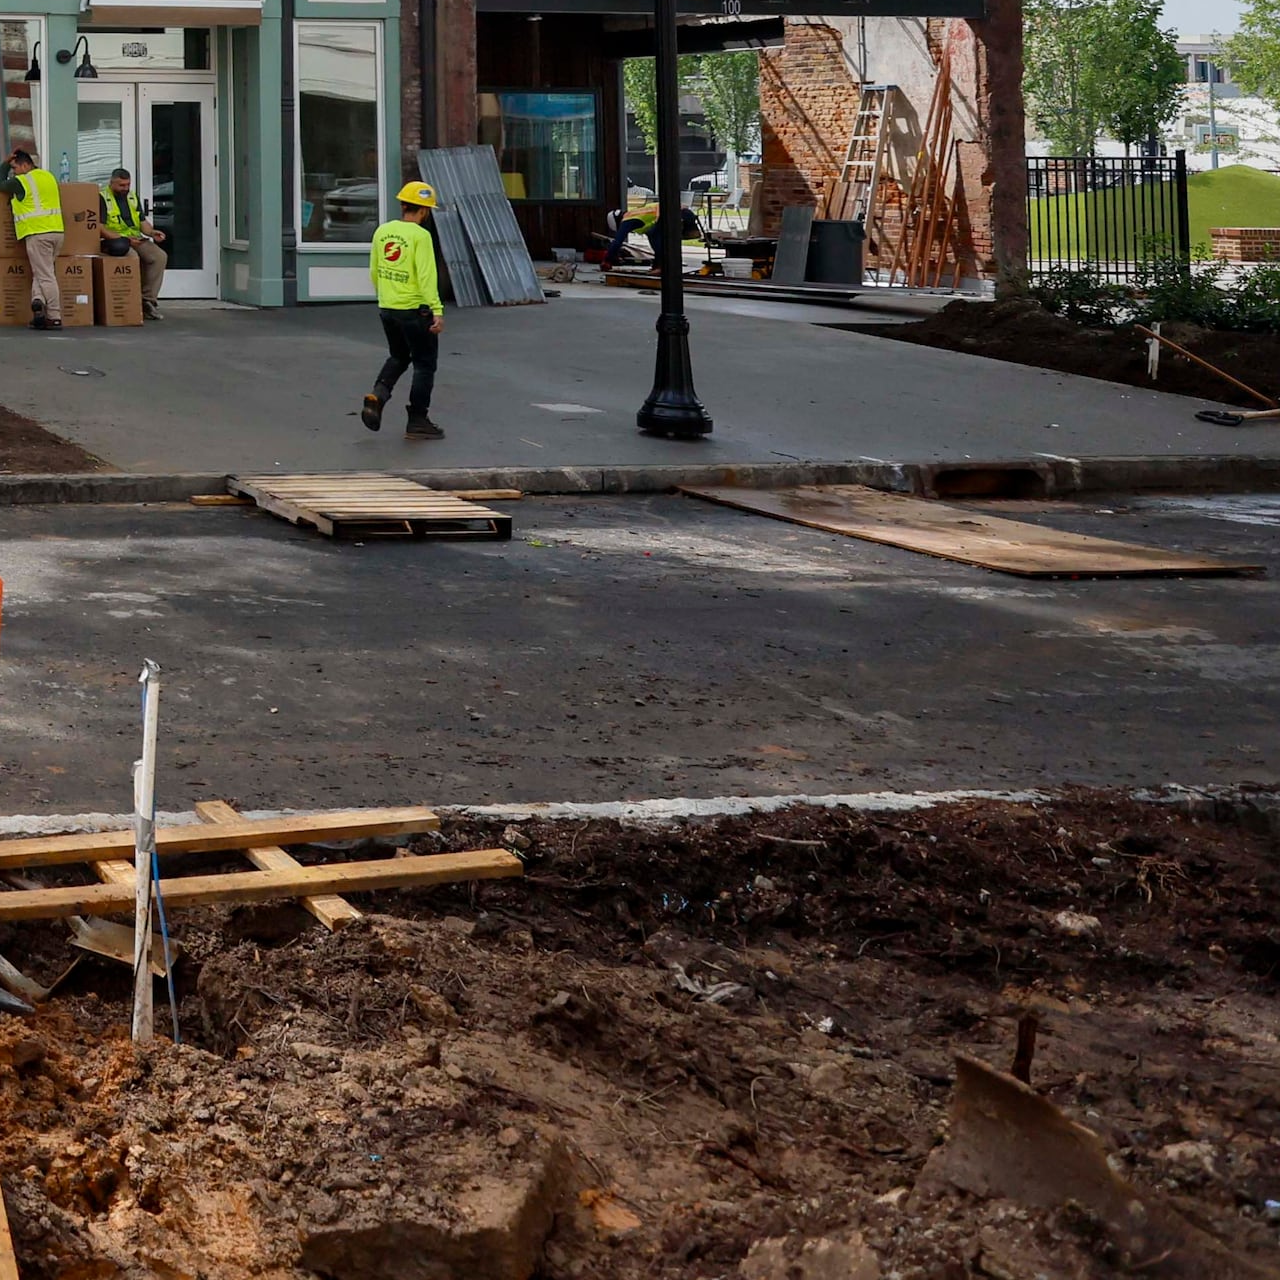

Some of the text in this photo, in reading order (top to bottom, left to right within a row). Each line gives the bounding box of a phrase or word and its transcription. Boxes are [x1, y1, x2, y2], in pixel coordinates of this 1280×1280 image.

[722, 0, 741, 15] 100
[86, 208, 97, 230] AIS
[7, 265, 25, 275] AIS
[65, 265, 83, 275] AIS
[114, 265, 132, 275] AIS
